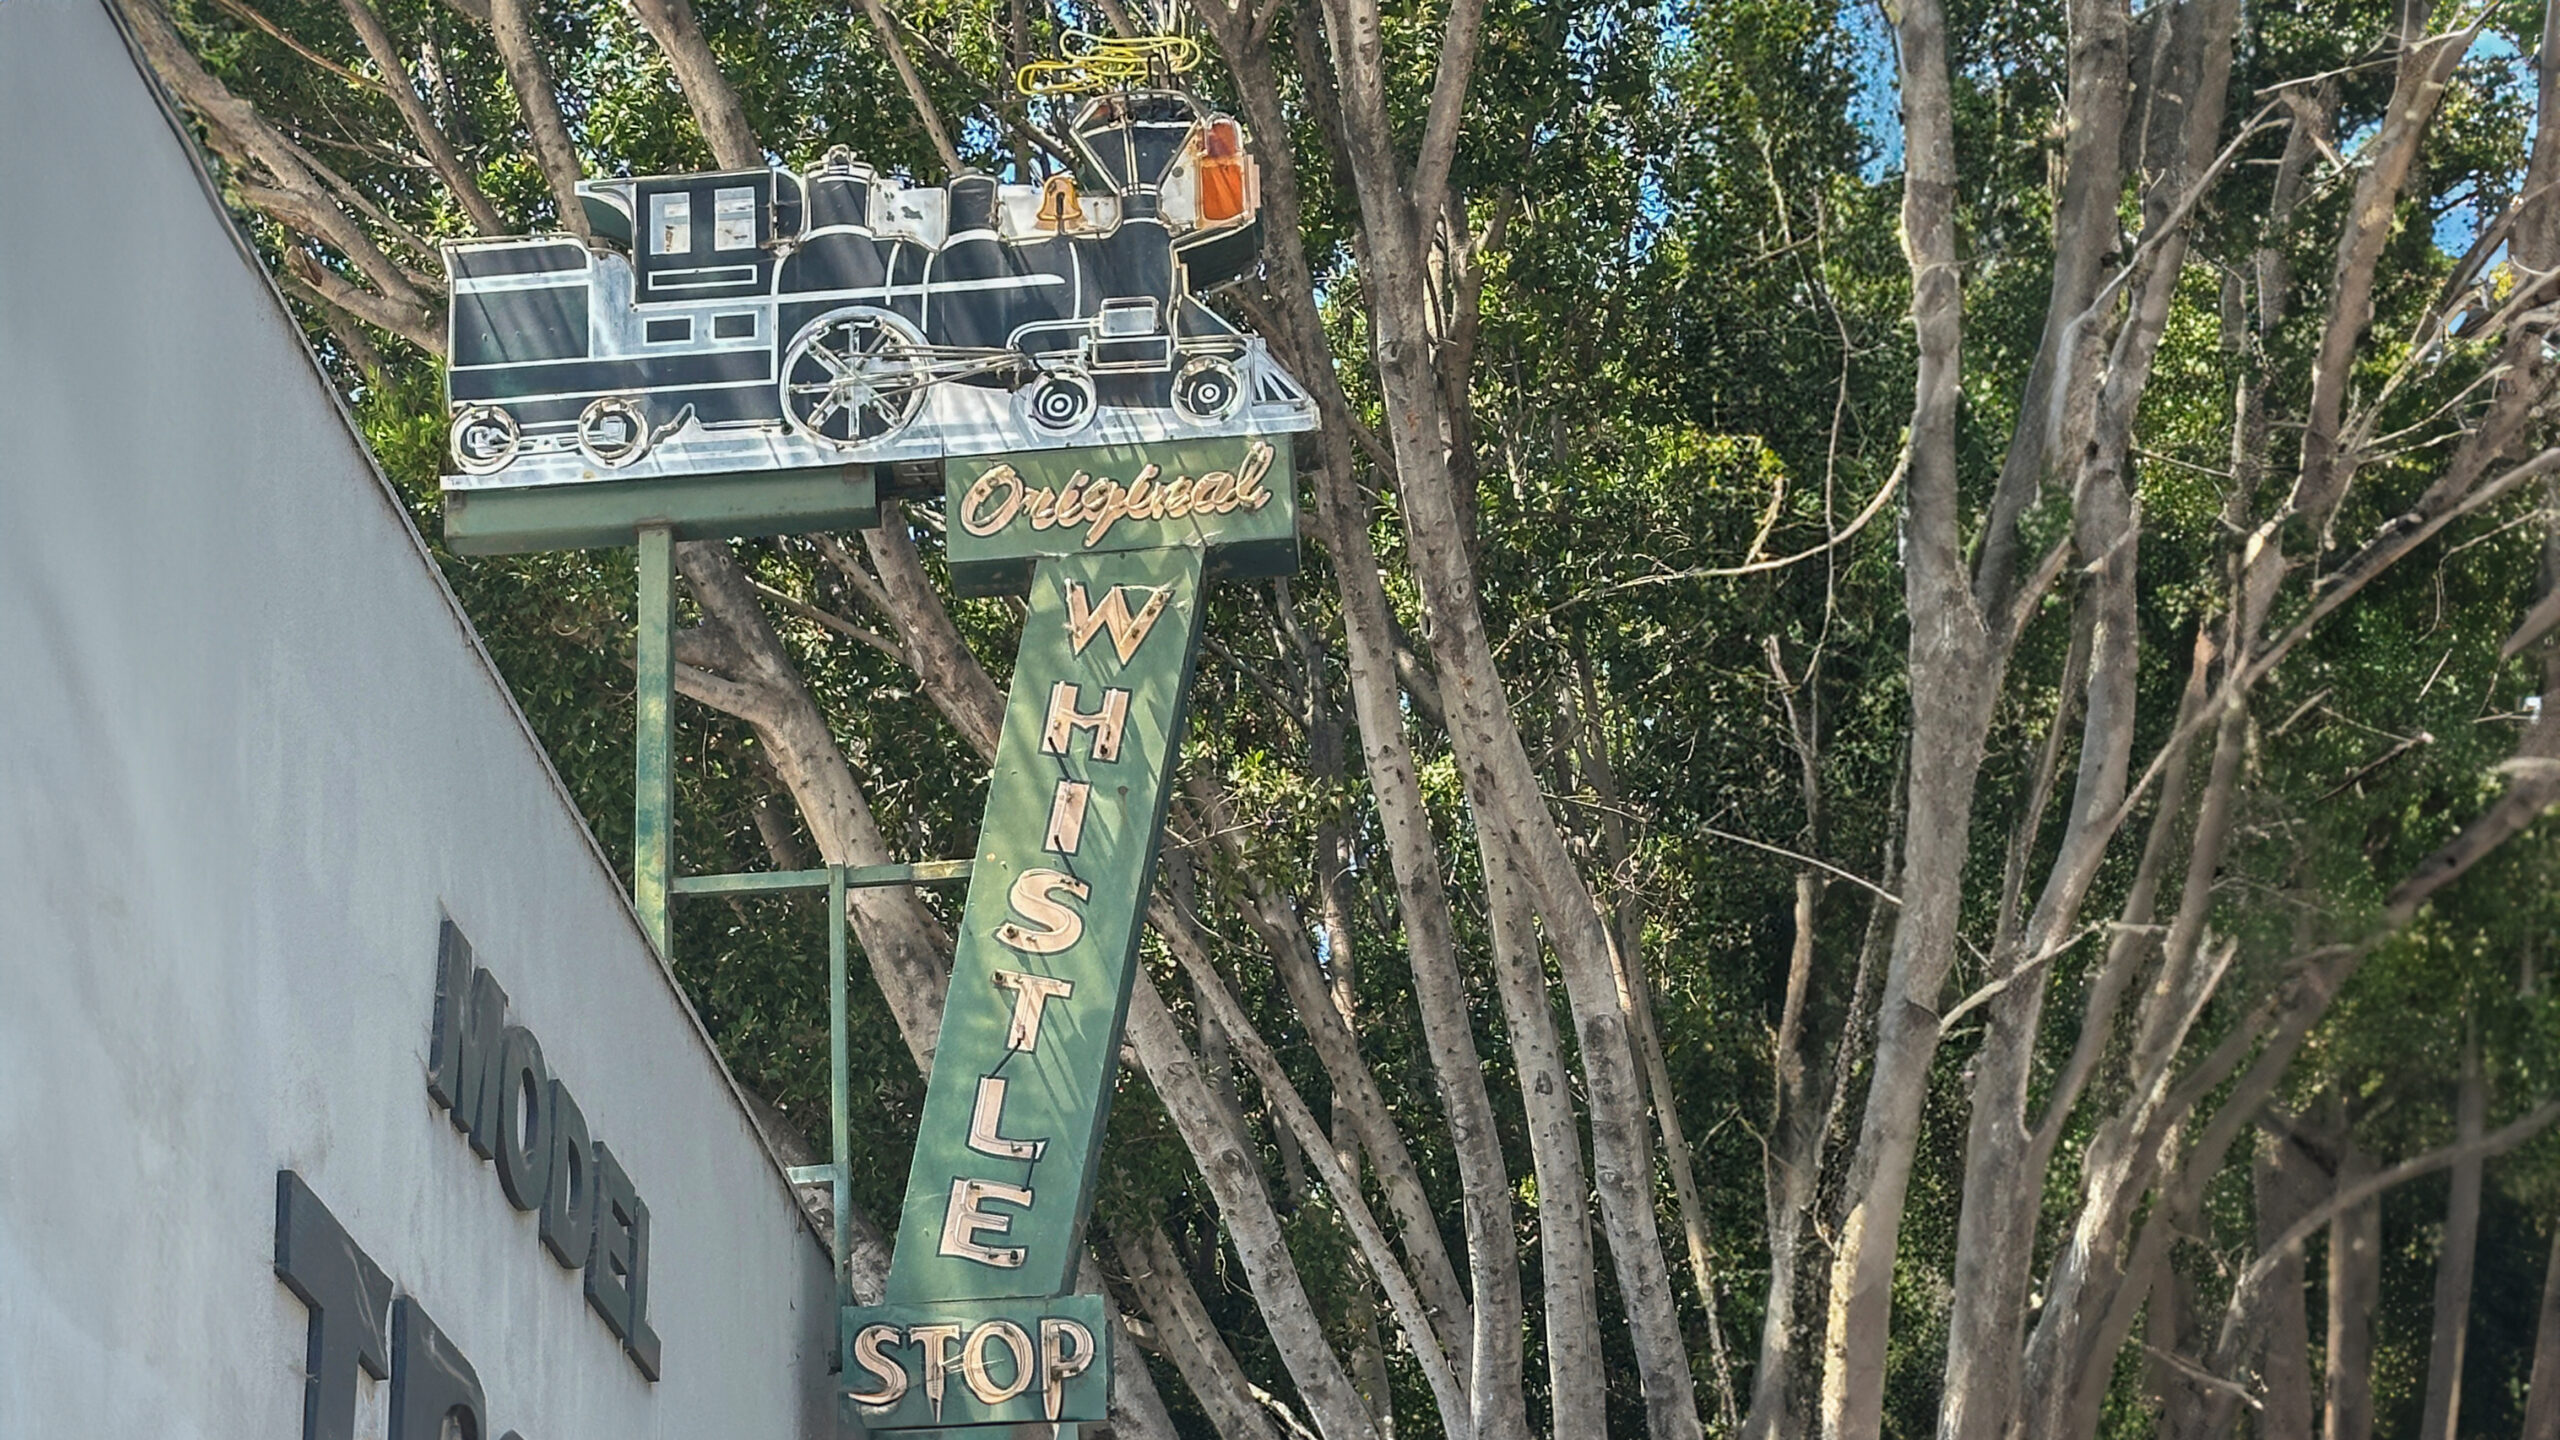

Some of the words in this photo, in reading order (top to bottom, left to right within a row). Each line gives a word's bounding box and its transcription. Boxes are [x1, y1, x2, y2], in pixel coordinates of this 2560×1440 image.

[960, 441, 1273, 547] Original
[939, 579, 1174, 1267] WHISTLE
[427, 917, 661, 1382] MODEL
[848, 1319, 1096, 1422] STOP
